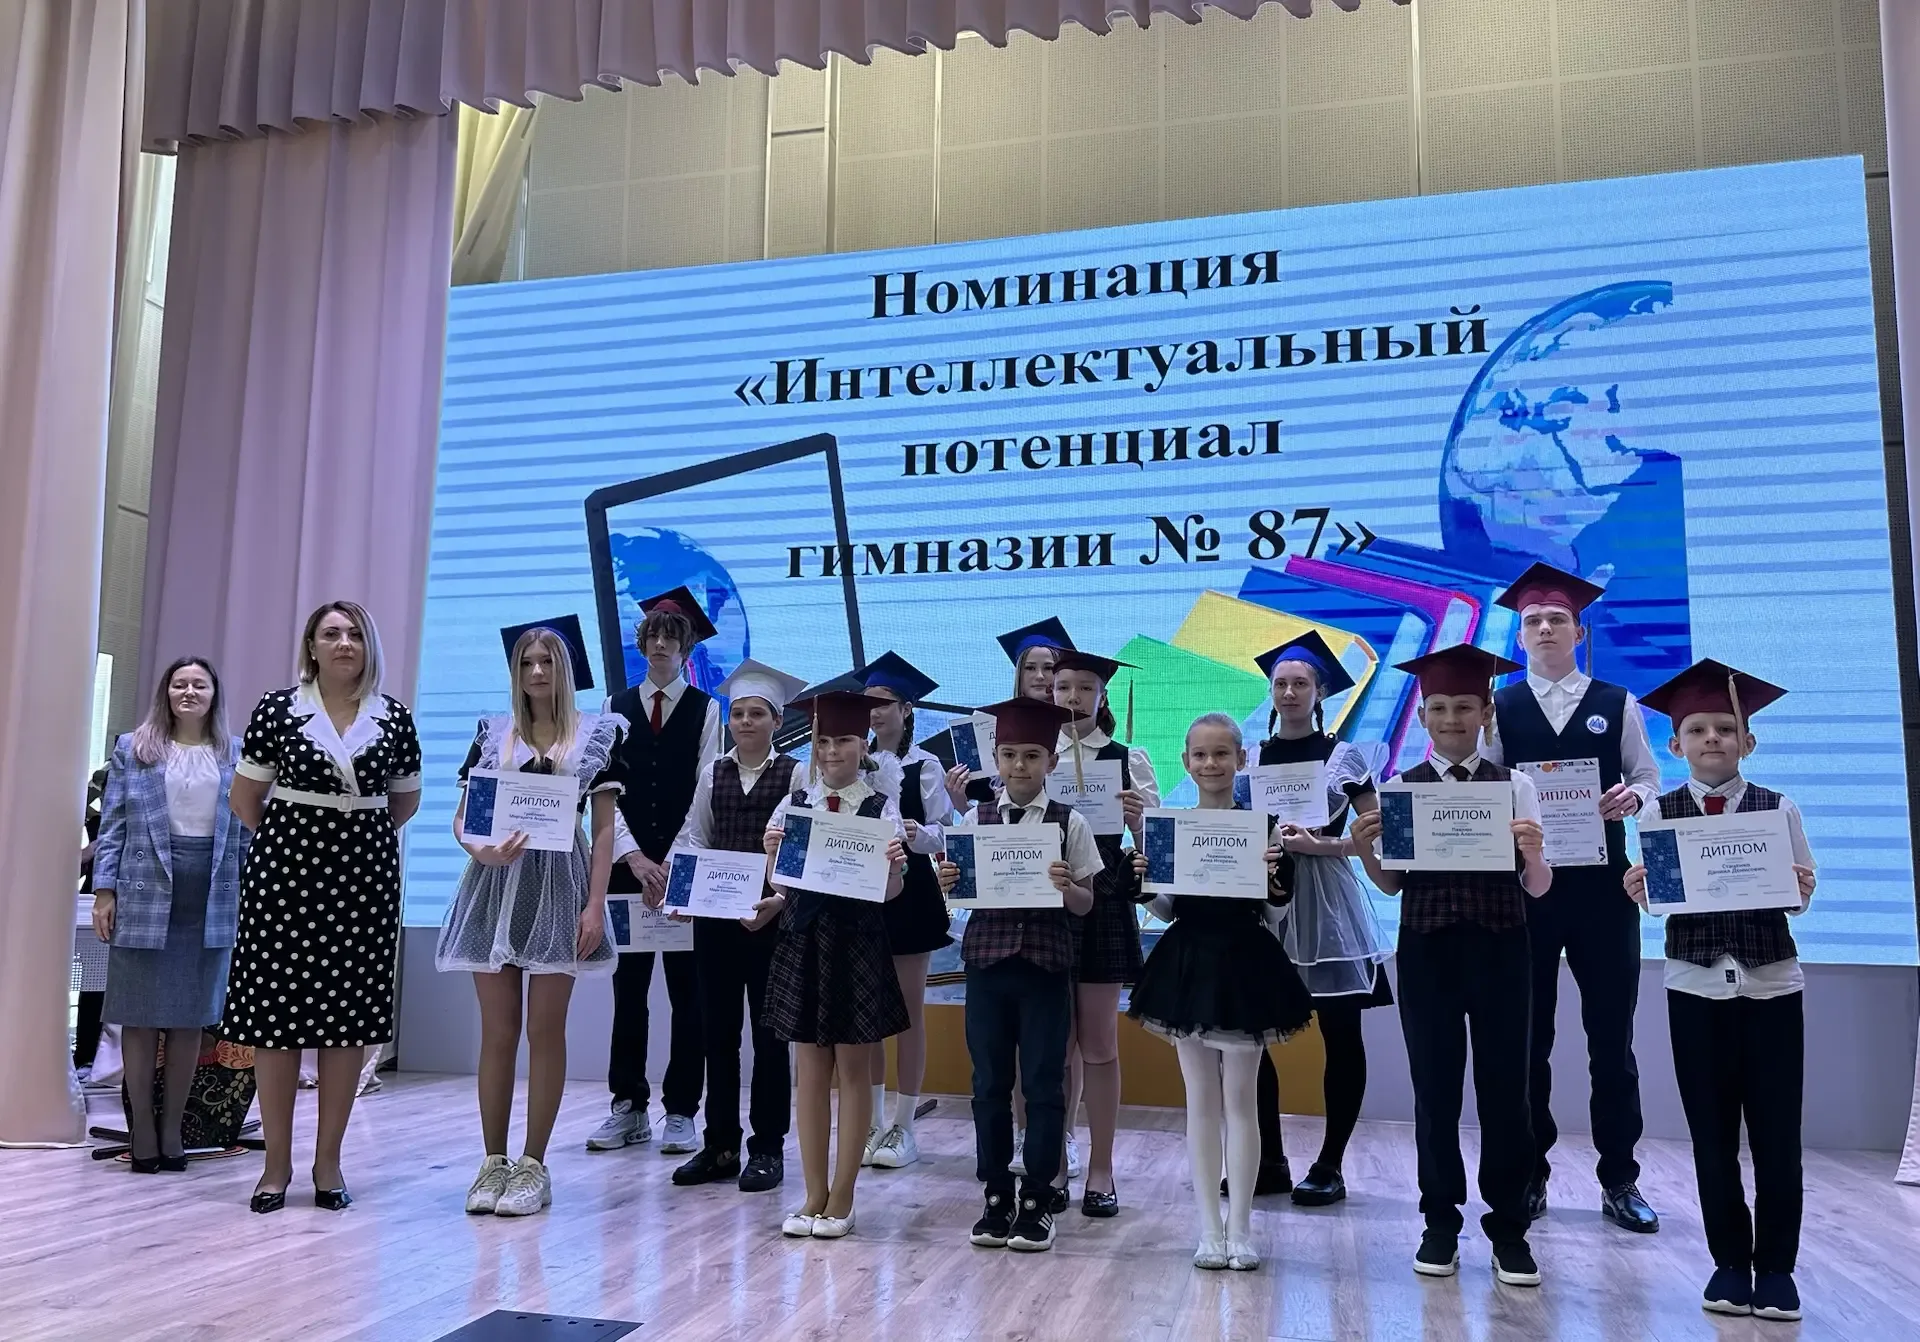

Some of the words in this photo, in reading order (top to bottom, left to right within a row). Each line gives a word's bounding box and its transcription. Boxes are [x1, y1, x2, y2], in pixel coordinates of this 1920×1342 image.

[869, 249, 1281, 319] Номинация
[734, 304, 1490, 406] «Интеллектуальный
[901, 419, 1282, 476] потенциал
[786, 533, 1115, 579] гимназии
[1139, 514, 1221, 566] №
[1247, 507, 1378, 560] 87»
[1265, 783, 1310, 795] ДИПЛОМ
[511, 795, 560, 808] ДИПЛОМ
[1431, 810, 1492, 821] ДИПЛОМ
[825, 837, 875, 854] ДИПЛОМ
[1192, 836, 1248, 848] ДИПЛОМ
[991, 850, 1043, 862] ДИПЛОМ
[1700, 842, 1768, 860] ДИПЛОМ
[706, 871, 750, 882] ДИПЛОМ
